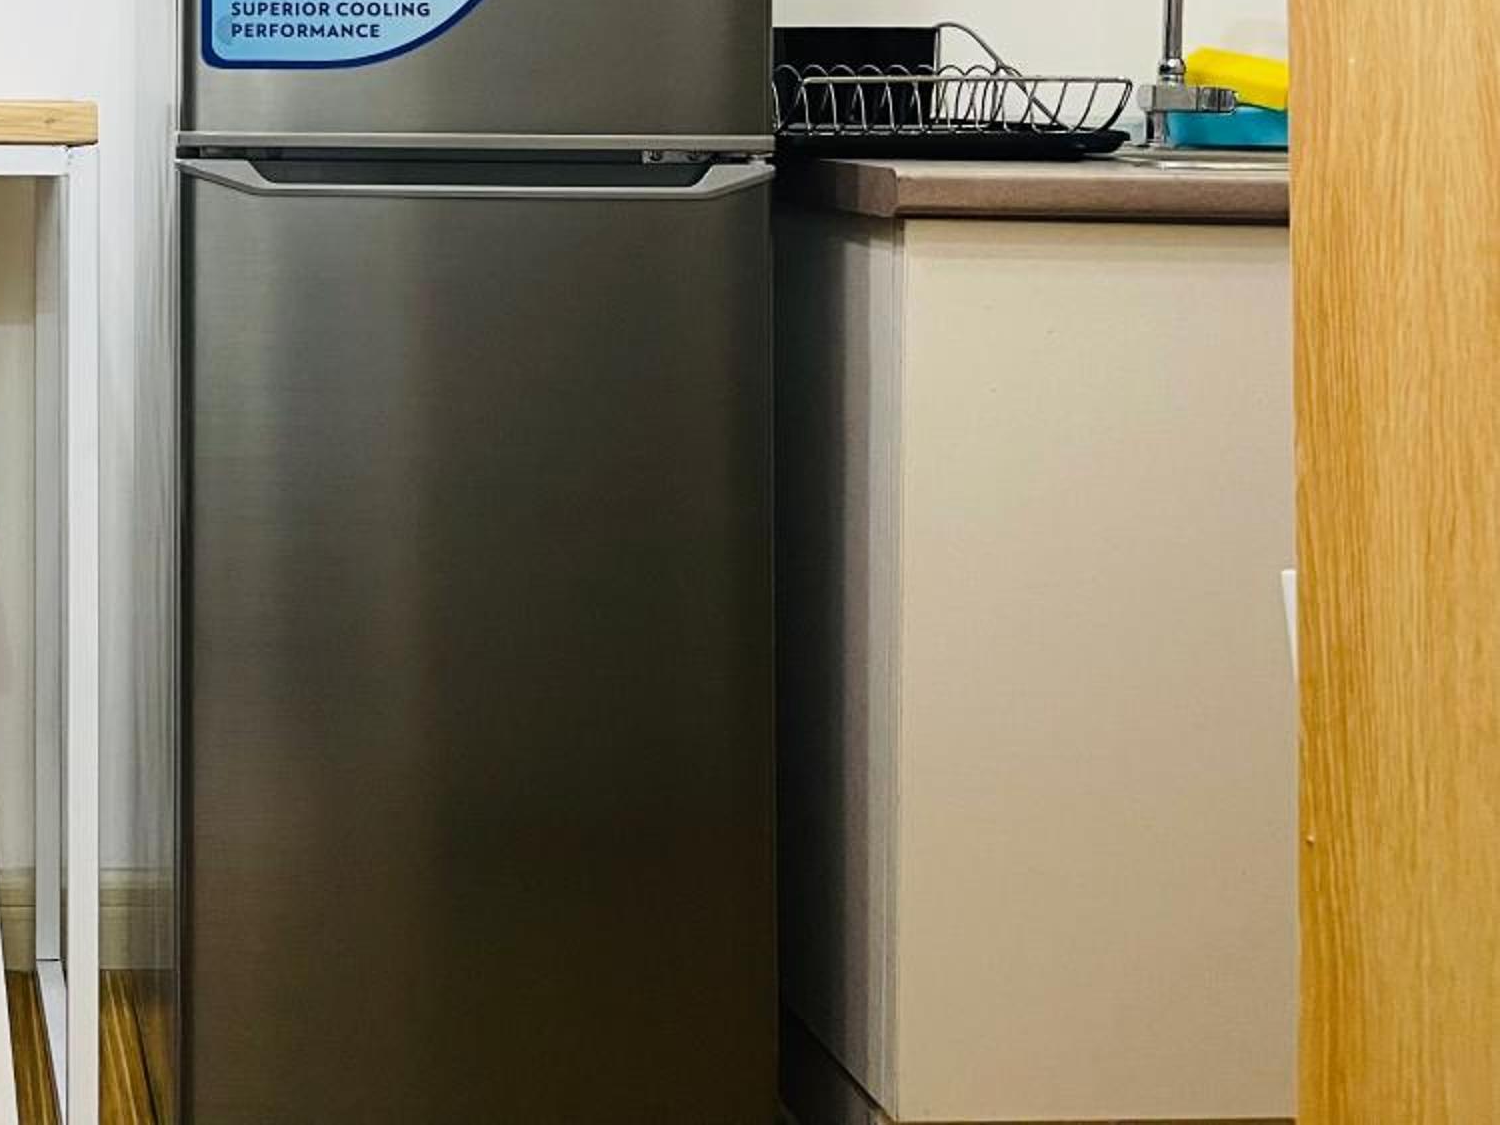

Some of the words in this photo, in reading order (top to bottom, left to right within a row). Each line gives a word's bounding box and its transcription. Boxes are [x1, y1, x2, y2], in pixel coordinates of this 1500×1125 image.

[231, 1, 331, 17] SUPERIOR
[336, 1, 431, 17] COOLING
[231, 23, 381, 38] PERFORMANCE
